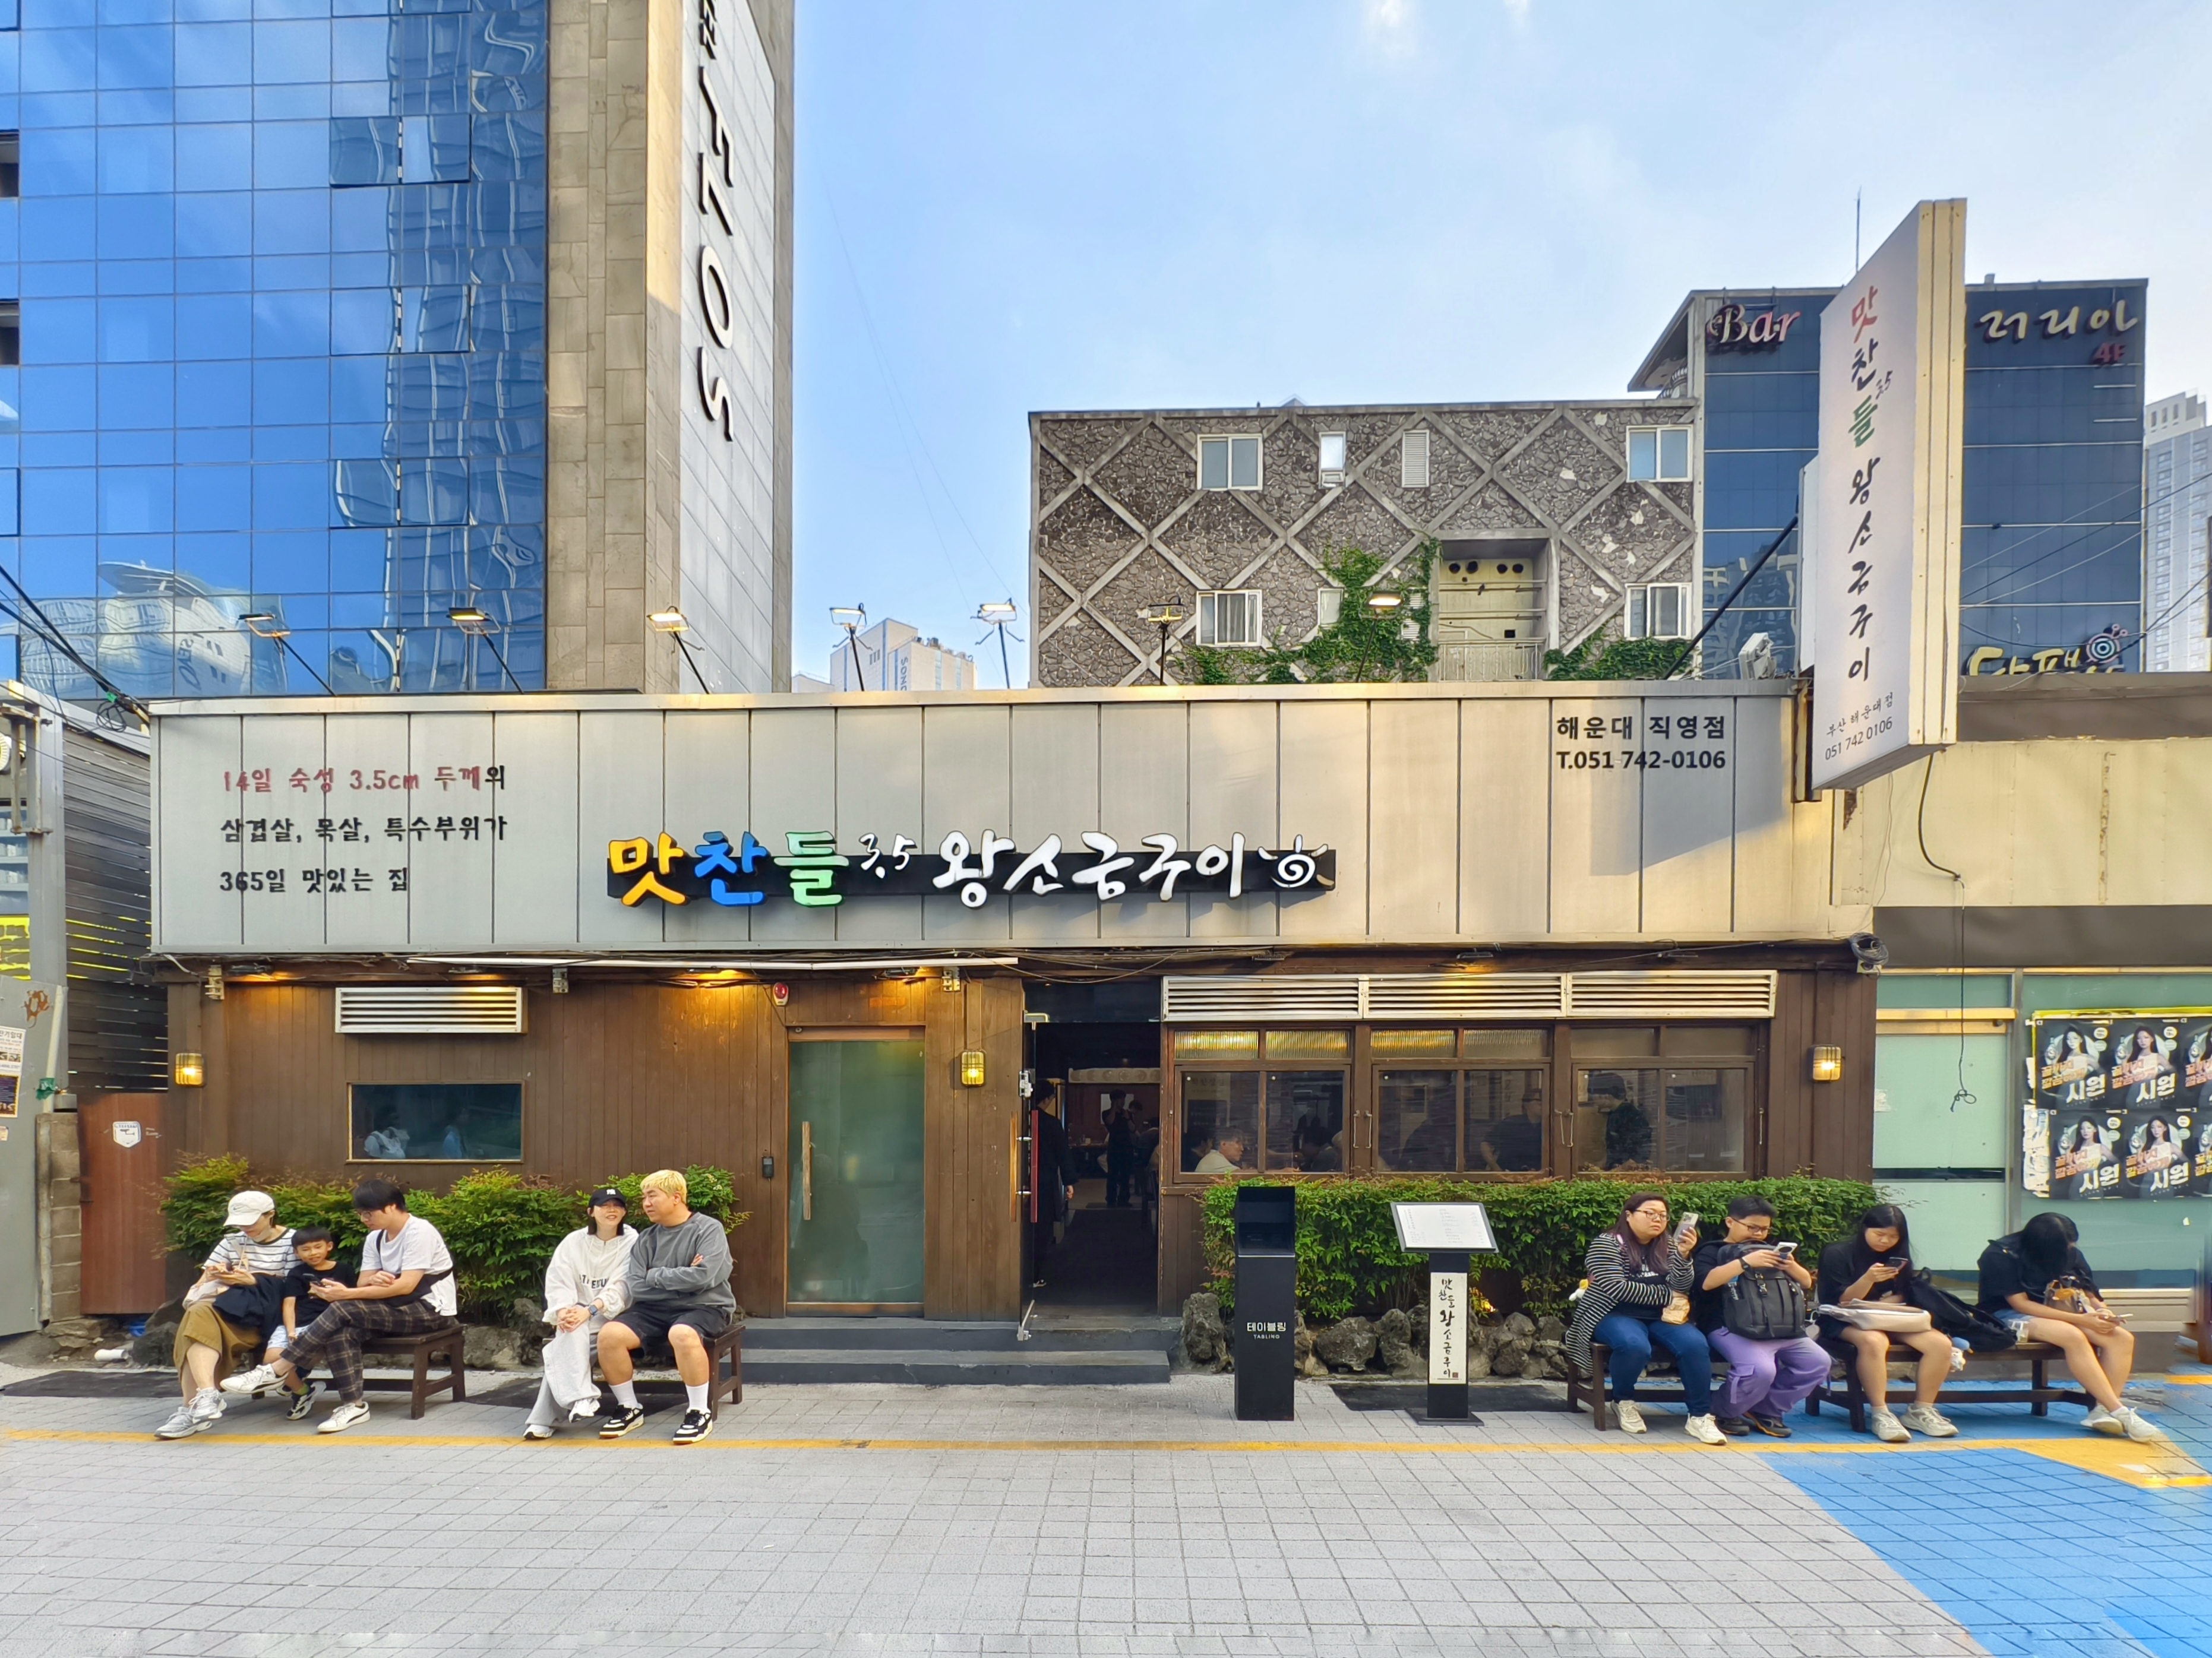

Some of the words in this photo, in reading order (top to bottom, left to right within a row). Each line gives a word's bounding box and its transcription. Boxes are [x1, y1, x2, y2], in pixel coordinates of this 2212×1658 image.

[698, 66, 734, 442] FLOS
[1707, 304, 1802, 343] Bar
[1848, 286, 1878, 448] 맛찬들
[1848, 457, 1881, 681] 왕소금구이
[1556, 716, 1633, 740] 해운대
[1648, 716, 1725, 739] 직영점
[1825, 742, 1841, 760] 051
[1846, 731, 1863, 750] 742
[1866, 716, 1892, 739] 0106
[1827, 718, 1846, 737] 부산
[224, 768, 271, 793] 14일
[289, 767, 334, 793] 숙성
[349, 770, 419, 790] 3.5cm
[220, 817, 302, 843] 삼겹살,
[315, 817, 369, 843] 목살,
[384, 816, 507, 841] 특수부위가
[220, 869, 286, 893] 365일
[302, 868, 373, 893] 맛있는
[388, 868, 408, 891] 집
[608, 831, 851, 907] 맛찬들
[859, 833, 918, 879] 3.5
[932, 830, 1245, 908] 왕소금구이
[2066, 1074, 2106, 1103] 시원
[2135, 1073, 2176, 1103] 시원
[2079, 1163, 2119, 1193] 시원
[2150, 1162, 2189, 1192] 시원
[1439, 1279, 1455, 1308] 맛찬들
[1247, 1322, 1286, 1331] 테이블링
[1440, 1310, 1455, 1378] 왕소금구이
